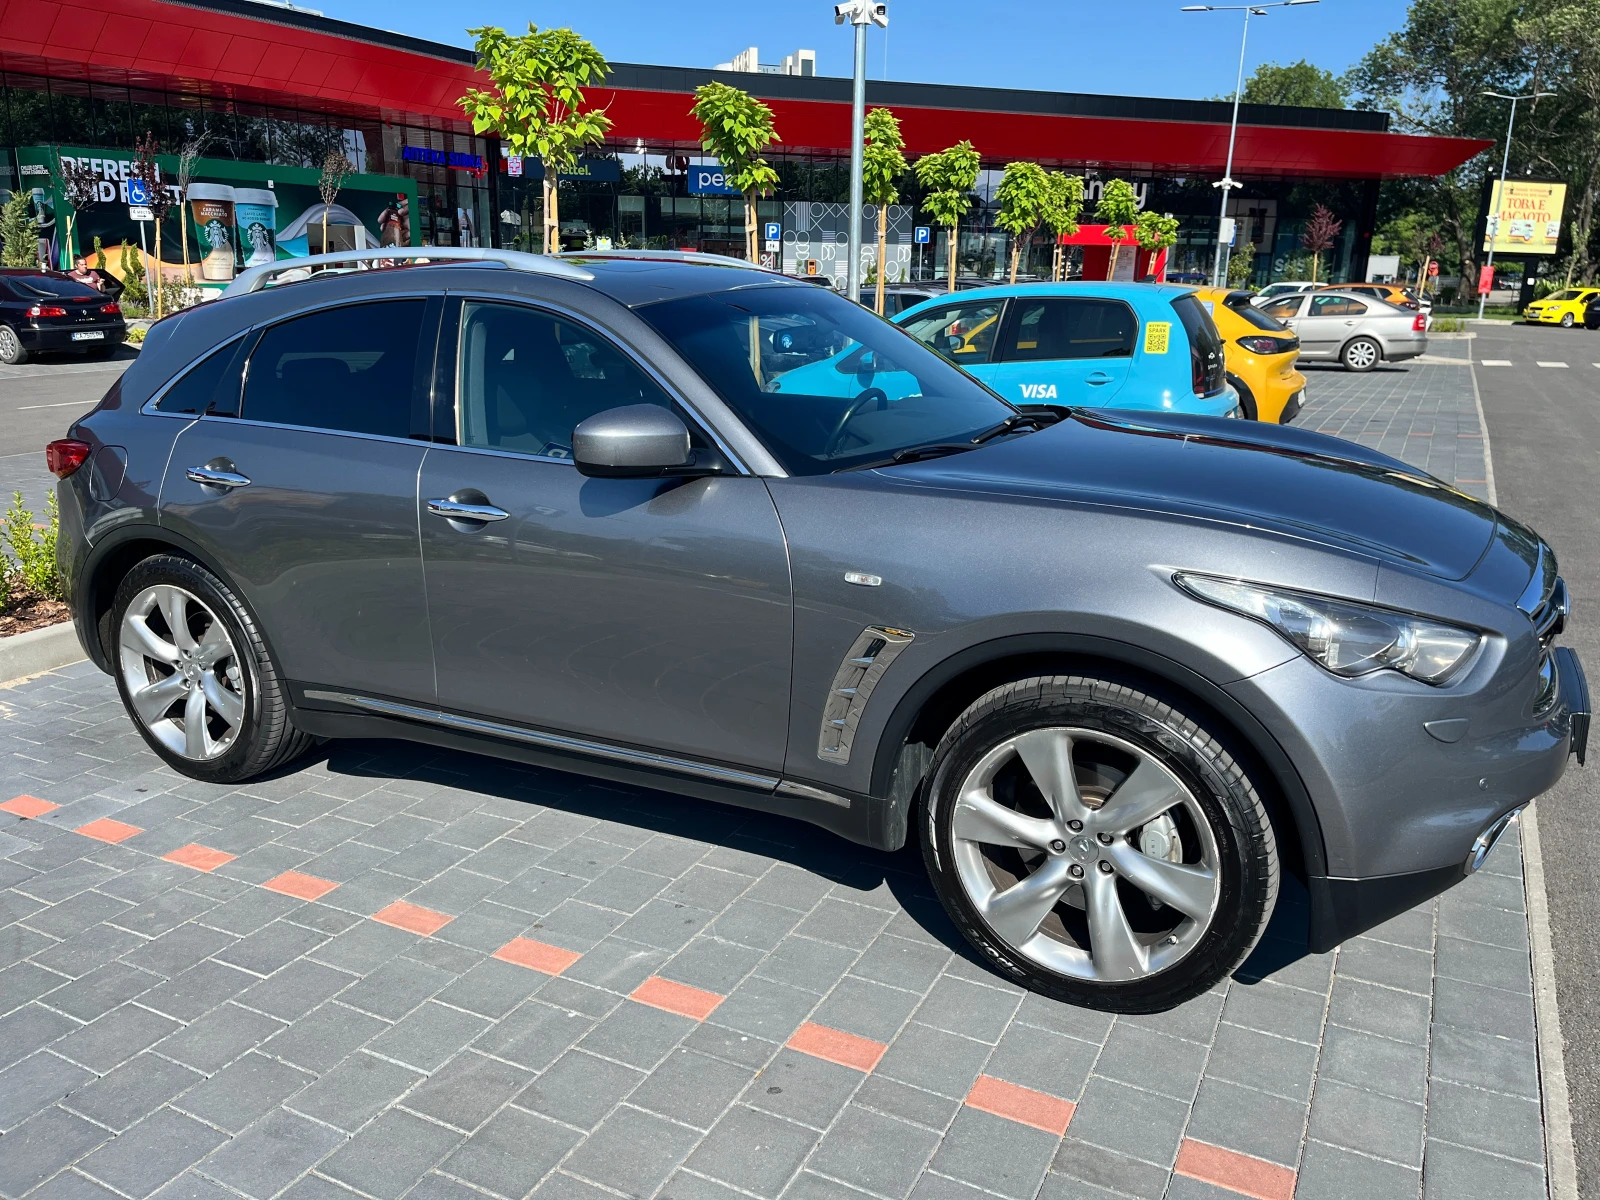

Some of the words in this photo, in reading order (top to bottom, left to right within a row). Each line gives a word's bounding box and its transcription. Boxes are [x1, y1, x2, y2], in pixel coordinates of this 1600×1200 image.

[698, 172, 734, 190] pep
[768, 225, 777, 238] P
[918, 229, 927, 241] P
[1018, 384, 1058, 399] VISA
